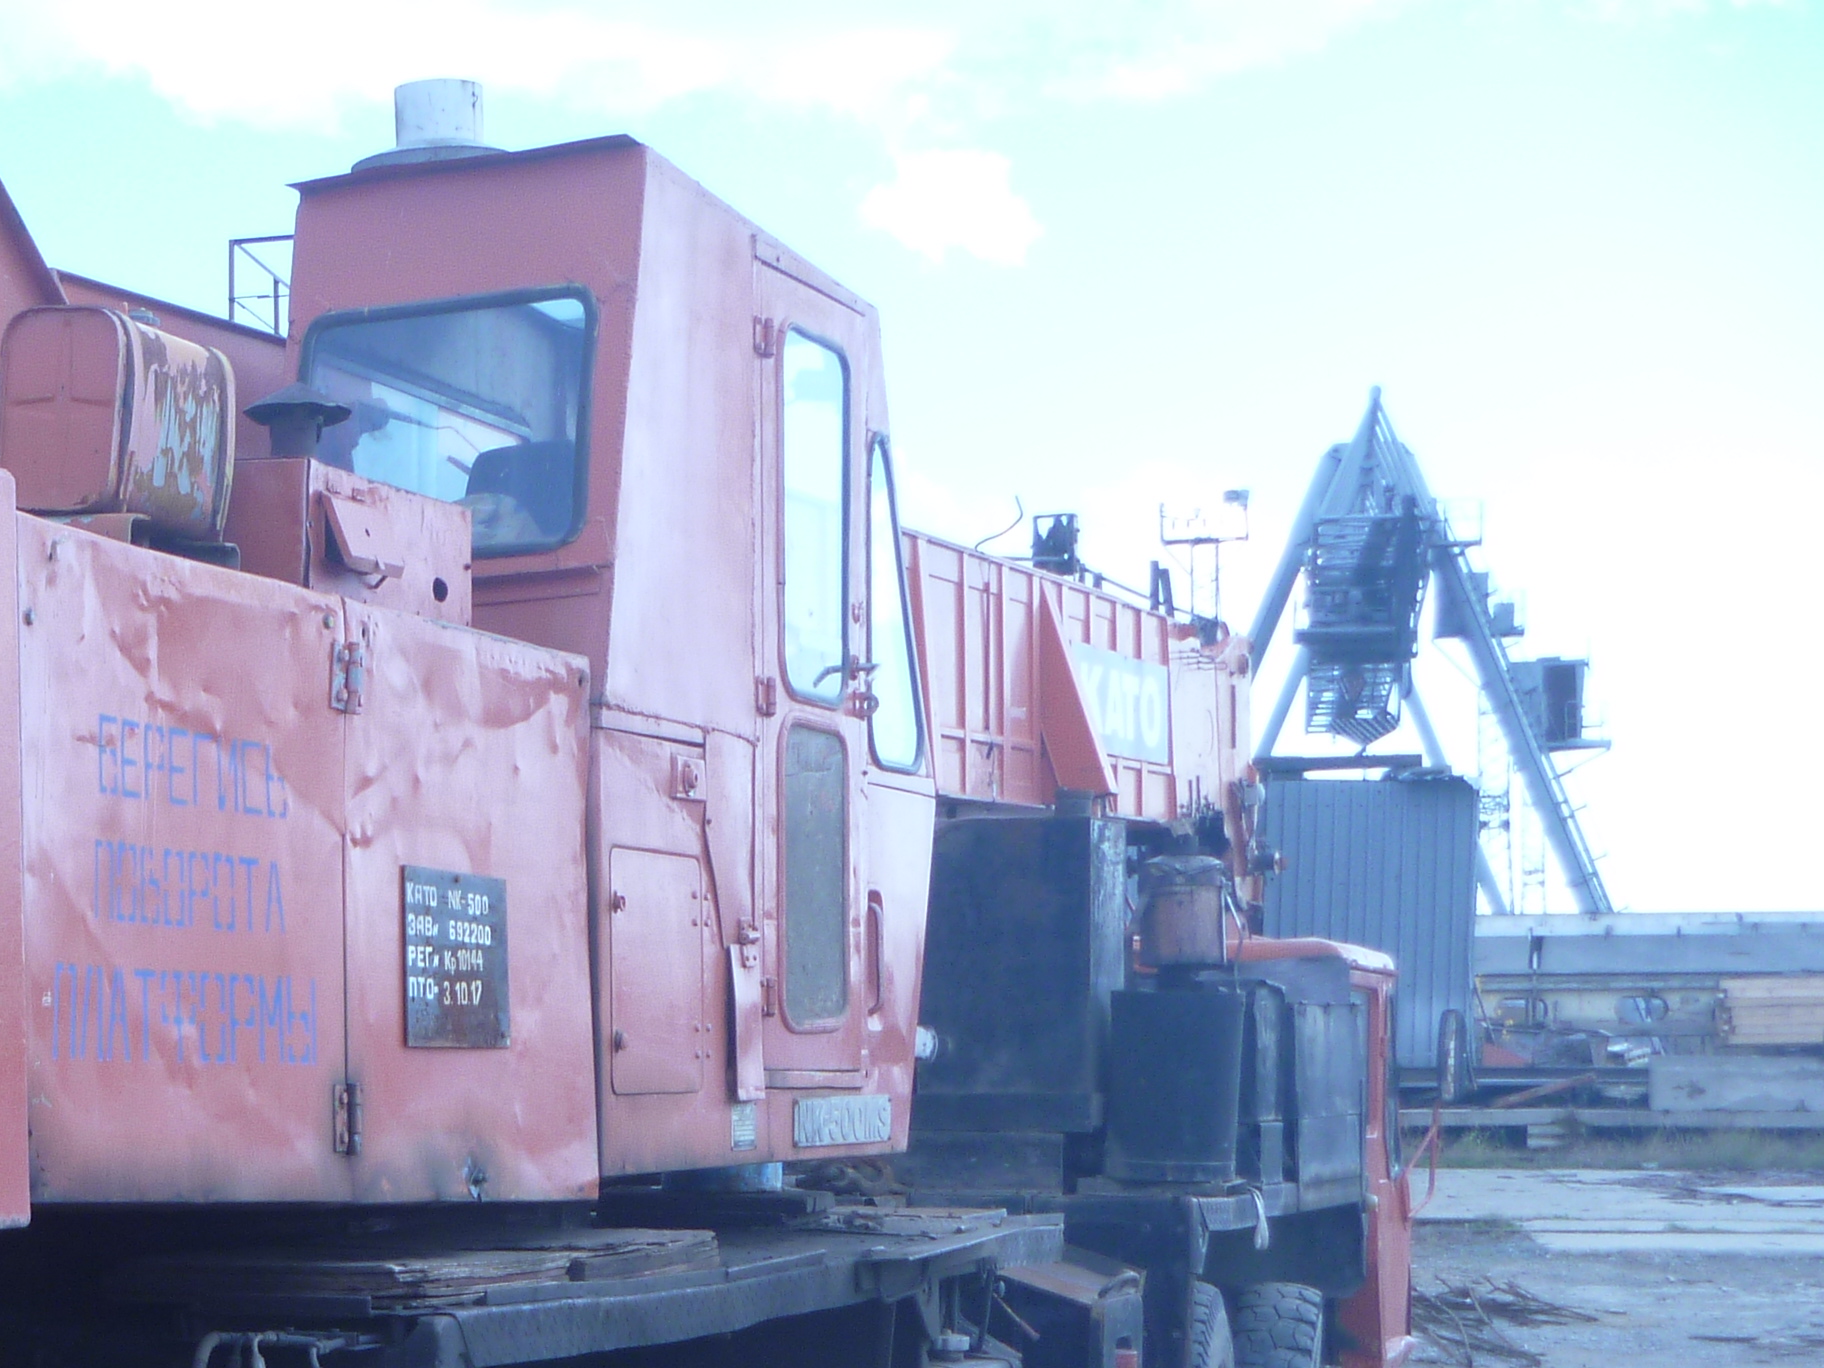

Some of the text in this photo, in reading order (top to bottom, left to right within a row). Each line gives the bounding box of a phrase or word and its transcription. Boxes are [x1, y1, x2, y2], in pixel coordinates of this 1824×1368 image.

[1080, 661, 1161, 748] KATO
[99, 713, 288, 818] БЕРЕГИСЬ
[94, 838, 286, 934] ПОВОРОТА
[448, 889, 489, 915] NK-500
[449, 920, 491, 945] 692200
[52, 961, 317, 1066] ПЛАТФОРМЫ
